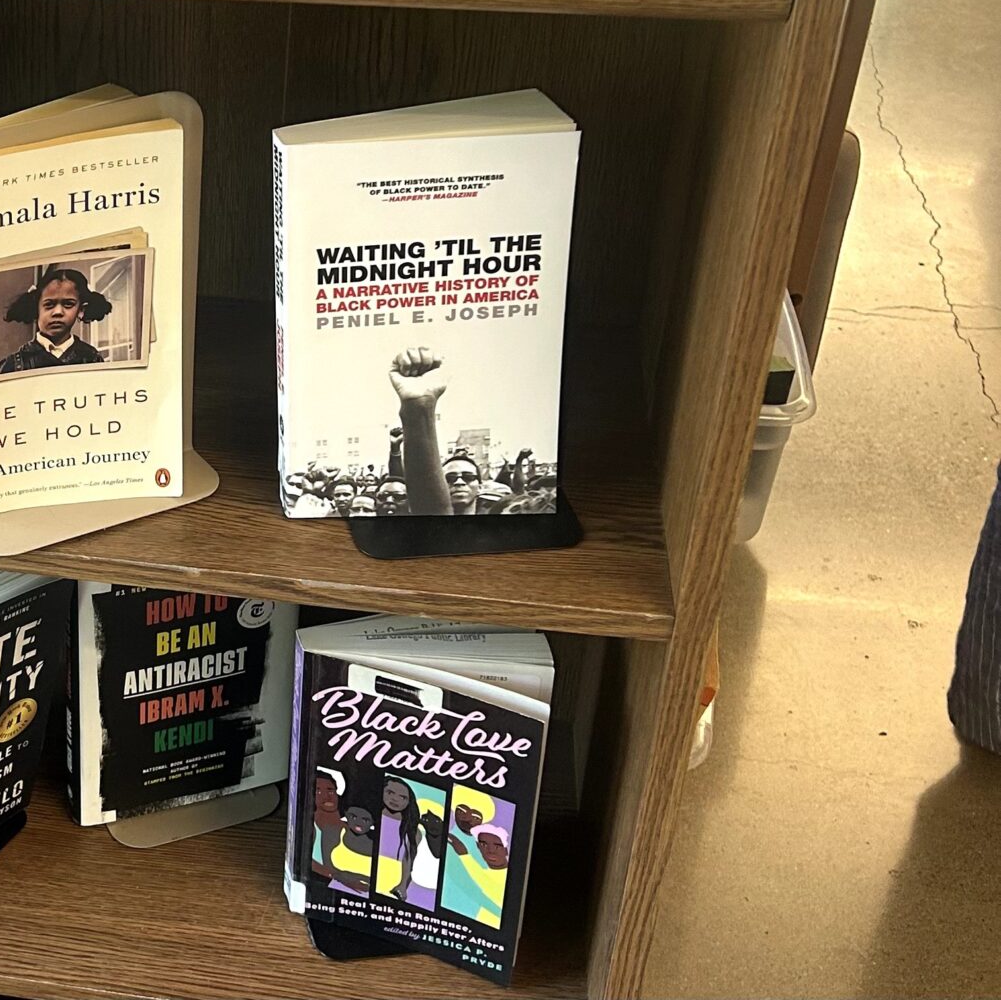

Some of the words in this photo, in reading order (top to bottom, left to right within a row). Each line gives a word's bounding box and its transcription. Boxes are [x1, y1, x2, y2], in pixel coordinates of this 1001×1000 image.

[380, 179, 402, 187] BEST
[404, 176, 455, 185] HISTORICAL
[458, 174, 504, 183] SYNTHESIS
[67, 182, 160, 214] Harris
[316, 242, 425, 264] WAITING
[435, 240, 480, 256] 'TIL
[490, 235, 542, 252] THE
[316, 260, 452, 285] MIDNIGHT
[463, 255, 541, 276] HOUR
[316, 299, 370, 313] BLACK
[377, 296, 436, 309] POWER
[441, 293, 457, 304] IN
[463, 289, 539, 303] AMERICA
[316, 312, 400, 329] PENIEL
[412, 310, 433, 323] E.
[445, 304, 538, 321] JOSEPH
[35, 389, 149, 415] TRUTHS
[45, 421, 122, 441] HOLD
[82, 449, 151, 469] Journey
[146, 593, 196, 626] HOW
[157, 628, 181, 656] BE
[187, 621, 216, 649] AN
[124, 647, 247, 696] ANTIRACIST
[139, 690, 204, 725] IBRAM
[211, 685, 229, 708] X.
[154, 719, 214, 753] KENDI
[312, 686, 446, 740] Black
[432, 708, 532, 762] Love
[328, 729, 508, 789] Matters
[305, 902, 336, 913] Being
[338, 906, 368, 919] Seen,
[371, 913, 392, 923] and
[395, 917, 446, 935] Happily
[449, 927, 467, 941] Ever
[469, 934, 504, 952] Afters
[341, 898, 363, 908] Real
[368, 901, 394, 915] Talk
[398, 908, 412, 918] on
[416, 912, 472, 934] Romance,
